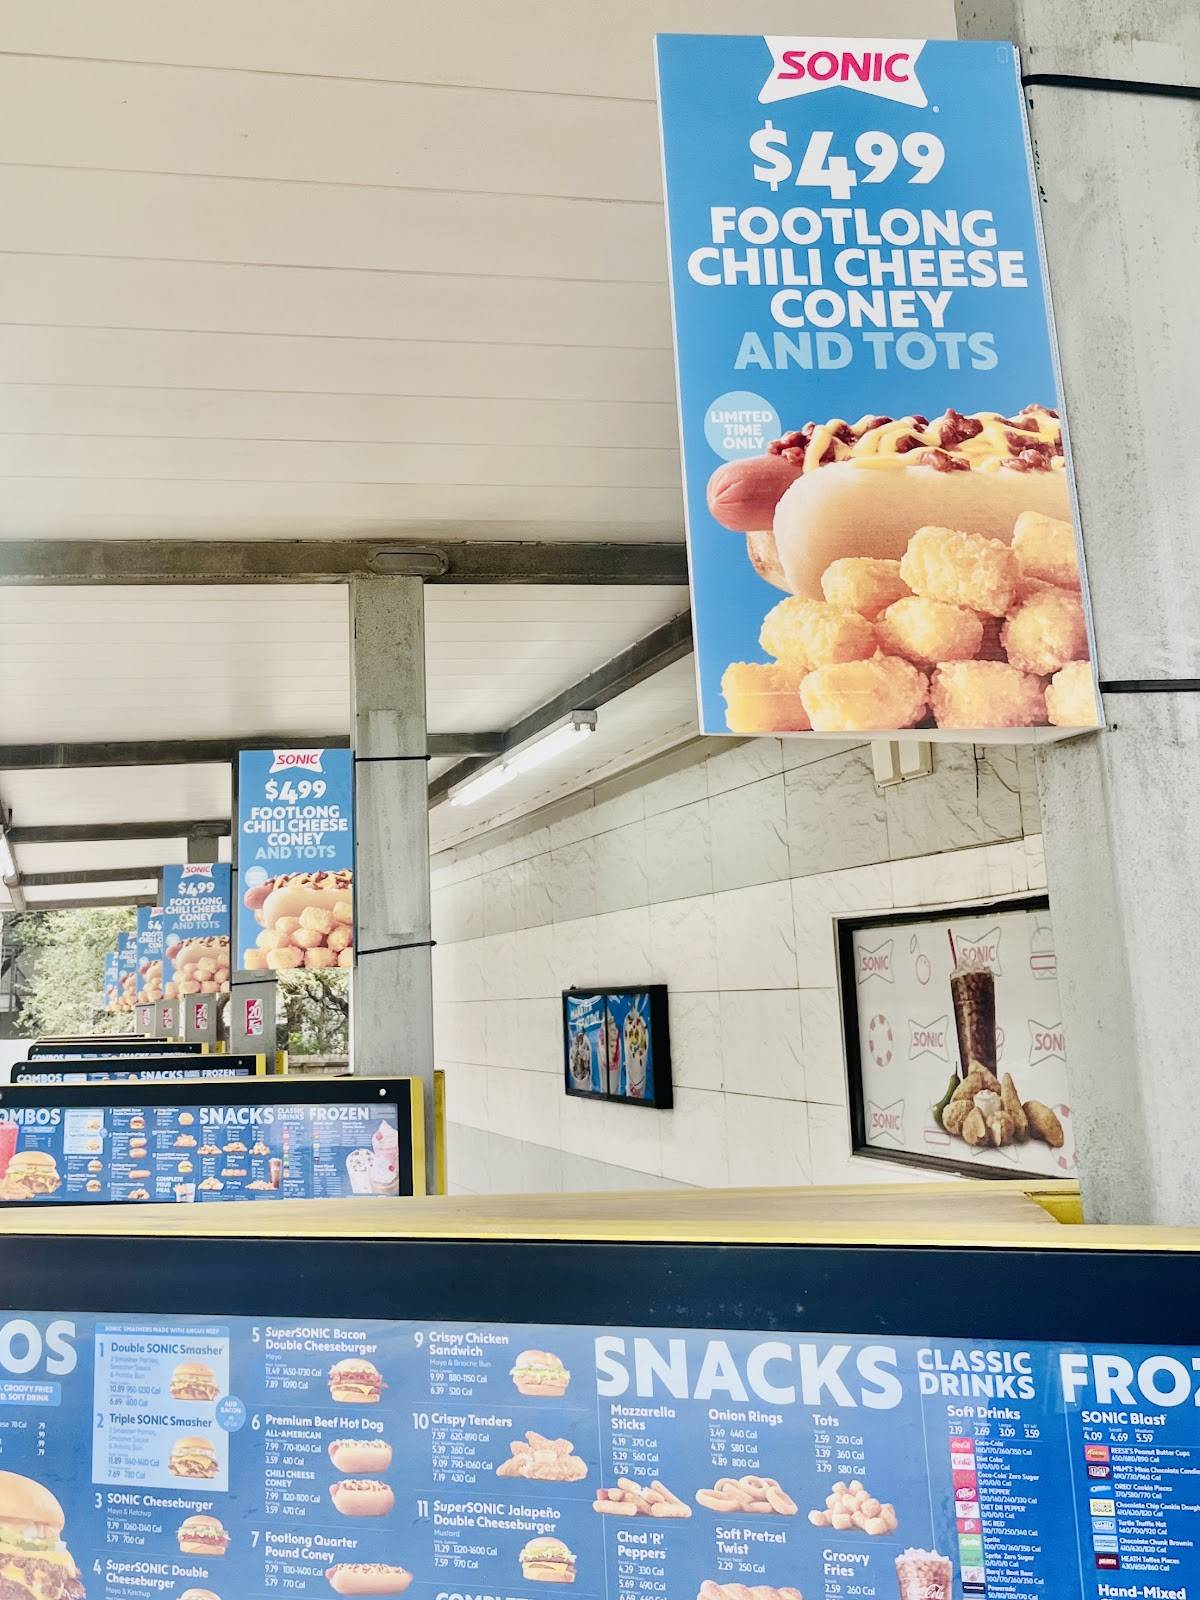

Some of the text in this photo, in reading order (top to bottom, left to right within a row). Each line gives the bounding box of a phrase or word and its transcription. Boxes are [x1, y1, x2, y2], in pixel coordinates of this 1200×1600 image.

[777, 51, 910, 83] SONIC
[711, 207, 998, 246] FOOTLONG
[687, 247, 1028, 288] CHILI CHEESE
[770, 289, 953, 328] CONEY
[733, 333, 998, 370] AND TOTS
[711, 410, 772, 425] LIMITED
[724, 424, 762, 437] TIME
[722, 436, 764, 449] ONLY
[276, 754, 319, 765] SONIC
[251, 806, 339, 819] FOOTLONG
[244, 818, 348, 833] CHILI CHEESE
[267, 832, 324, 846] CONEY
[255, 845, 336, 860] AND TOTS
[185, 865, 210, 873] SONIC
[170, 897, 222, 905] FOOTLONG
[165, 904, 227, 914] CHILI CHEESE
[180, 913, 212, 922] CONEY
[196, 921, 220, 929] TOTS
[862, 956, 888, 970] SONIC
[913, 1031, 944, 1047] SONIC
[17, 1069, 235, 1083] COMBOS SNACKS FROZEN
[200, 1108, 274, 1124] SNACKS
[310, 1108, 369, 1120] FROZEN
[872, 1111, 900, 1130] SONIC
[252, 1327, 366, 1343] 5 SuperSONIC Bacon
[415, 1332, 509, 1348] 9 Crispy Chicken
[111, 1343, 145, 1353] Double
[146, 1344, 179, 1353] SONIC
[180, 1345, 223, 1356] Smasher
[266, 1341, 377, 1355] Double Cheeseburger
[430, 1345, 482, 1356] Sandwich
[917, 1348, 1032, 1374] CLASSIC
[595, 1336, 903, 1410] SNACKS
[461, 1387, 472, 1396] Cal
[920, 1372, 1035, 1400] DRINKS
[610, 1404, 676, 1418] Mozzarella
[708, 1409, 784, 1425] Onion Rings
[947, 1405, 1021, 1420] Soft Drinks
[97, 1413, 212, 1428] 2 Triple SONIC Smasher
[252, 1414, 260, 1430] 6
[265, 1414, 313, 1427] Premium
[314, 1416, 338, 1429] Beef
[339, 1418, 360, 1430] Hot
[362, 1419, 383, 1432] Dog
[413, 1413, 512, 1429] 10 Crispy Tenders
[612, 1418, 646, 1430] Sticks
[812, 1414, 839, 1427] Tots
[1082, 1411, 1165, 1426] SONIC Blast
[265, 1429, 321, 1439] ALL-AMERICAN
[730, 1430, 744, 1438] 440
[745, 1430, 757, 1439] Cal
[975, 1427, 990, 1436] 2.69
[999, 1428, 1015, 1437] 3.09
[1025, 1429, 1040, 1439] 3.59
[1084, 1432, 1153, 1443] 4.09 4.69 5.59
[464, 1447, 475, 1456] Cal
[646, 1452, 658, 1462] Cal
[836, 1450, 850, 1459] 360
[852, 1451, 864, 1460] Cal
[265, 1470, 315, 1480] CHILI CHEESE
[465, 1475, 475, 1483] Cal
[265, 1479, 292, 1488] CONEY
[95, 1494, 213, 1512] 3 SONIC Cheeseburger
[417, 1501, 560, 1519] 11 SuperSONIC Jalapeño
[434, 1515, 556, 1533] Double Cheeseburger
[251, 1531, 357, 1547] 7 Footlong Quarter
[617, 1531, 647, 1544] Ched
[716, 1527, 786, 1544] Soft Pretzel
[265, 1545, 335, 1563] Pound Coney
[618, 1546, 666, 1561] Peppers
[716, 1542, 749, 1555] Twist
[467, 1560, 478, 1569] Cal
[822, 1550, 869, 1566] Groovy
[93, 1560, 208, 1579] 4 SuperSONIC Double
[824, 1564, 854, 1576] Fries
[106, 1574, 175, 1590] Cheeseburger
[1098, 1584, 1186, 1599] Hand-Mixed
